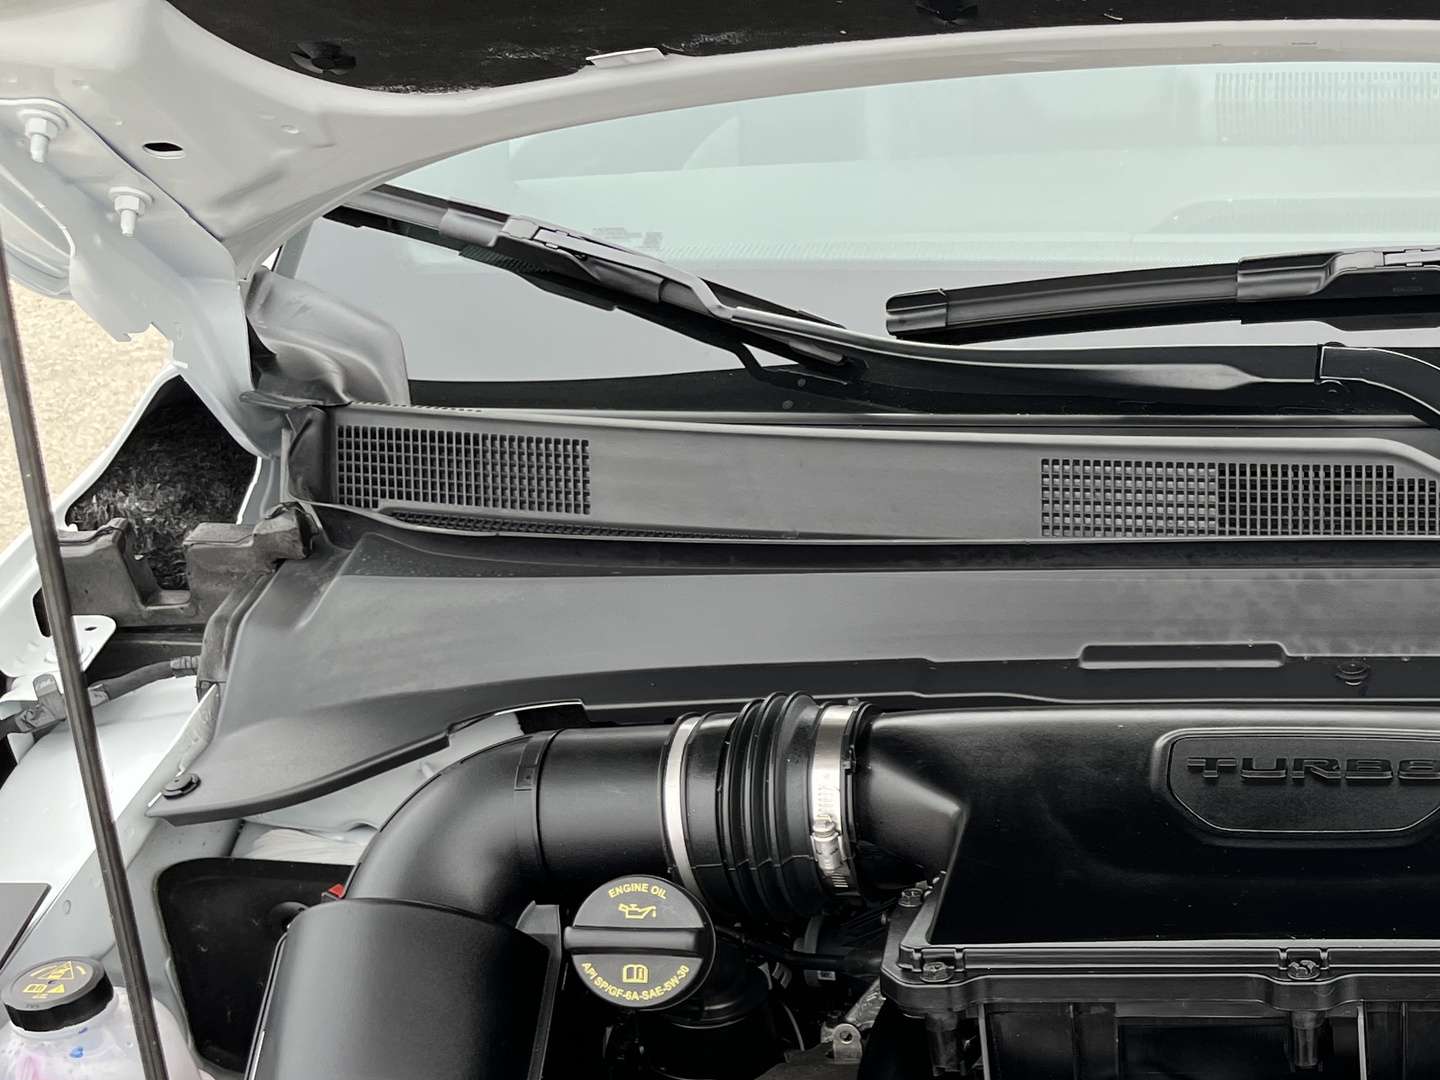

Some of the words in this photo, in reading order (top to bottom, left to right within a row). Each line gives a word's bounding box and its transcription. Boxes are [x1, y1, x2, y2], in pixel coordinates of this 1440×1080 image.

[608, 882, 649, 899] ENGINE
[650, 886, 668, 900] OIL
[581, 961, 598, 980] API
